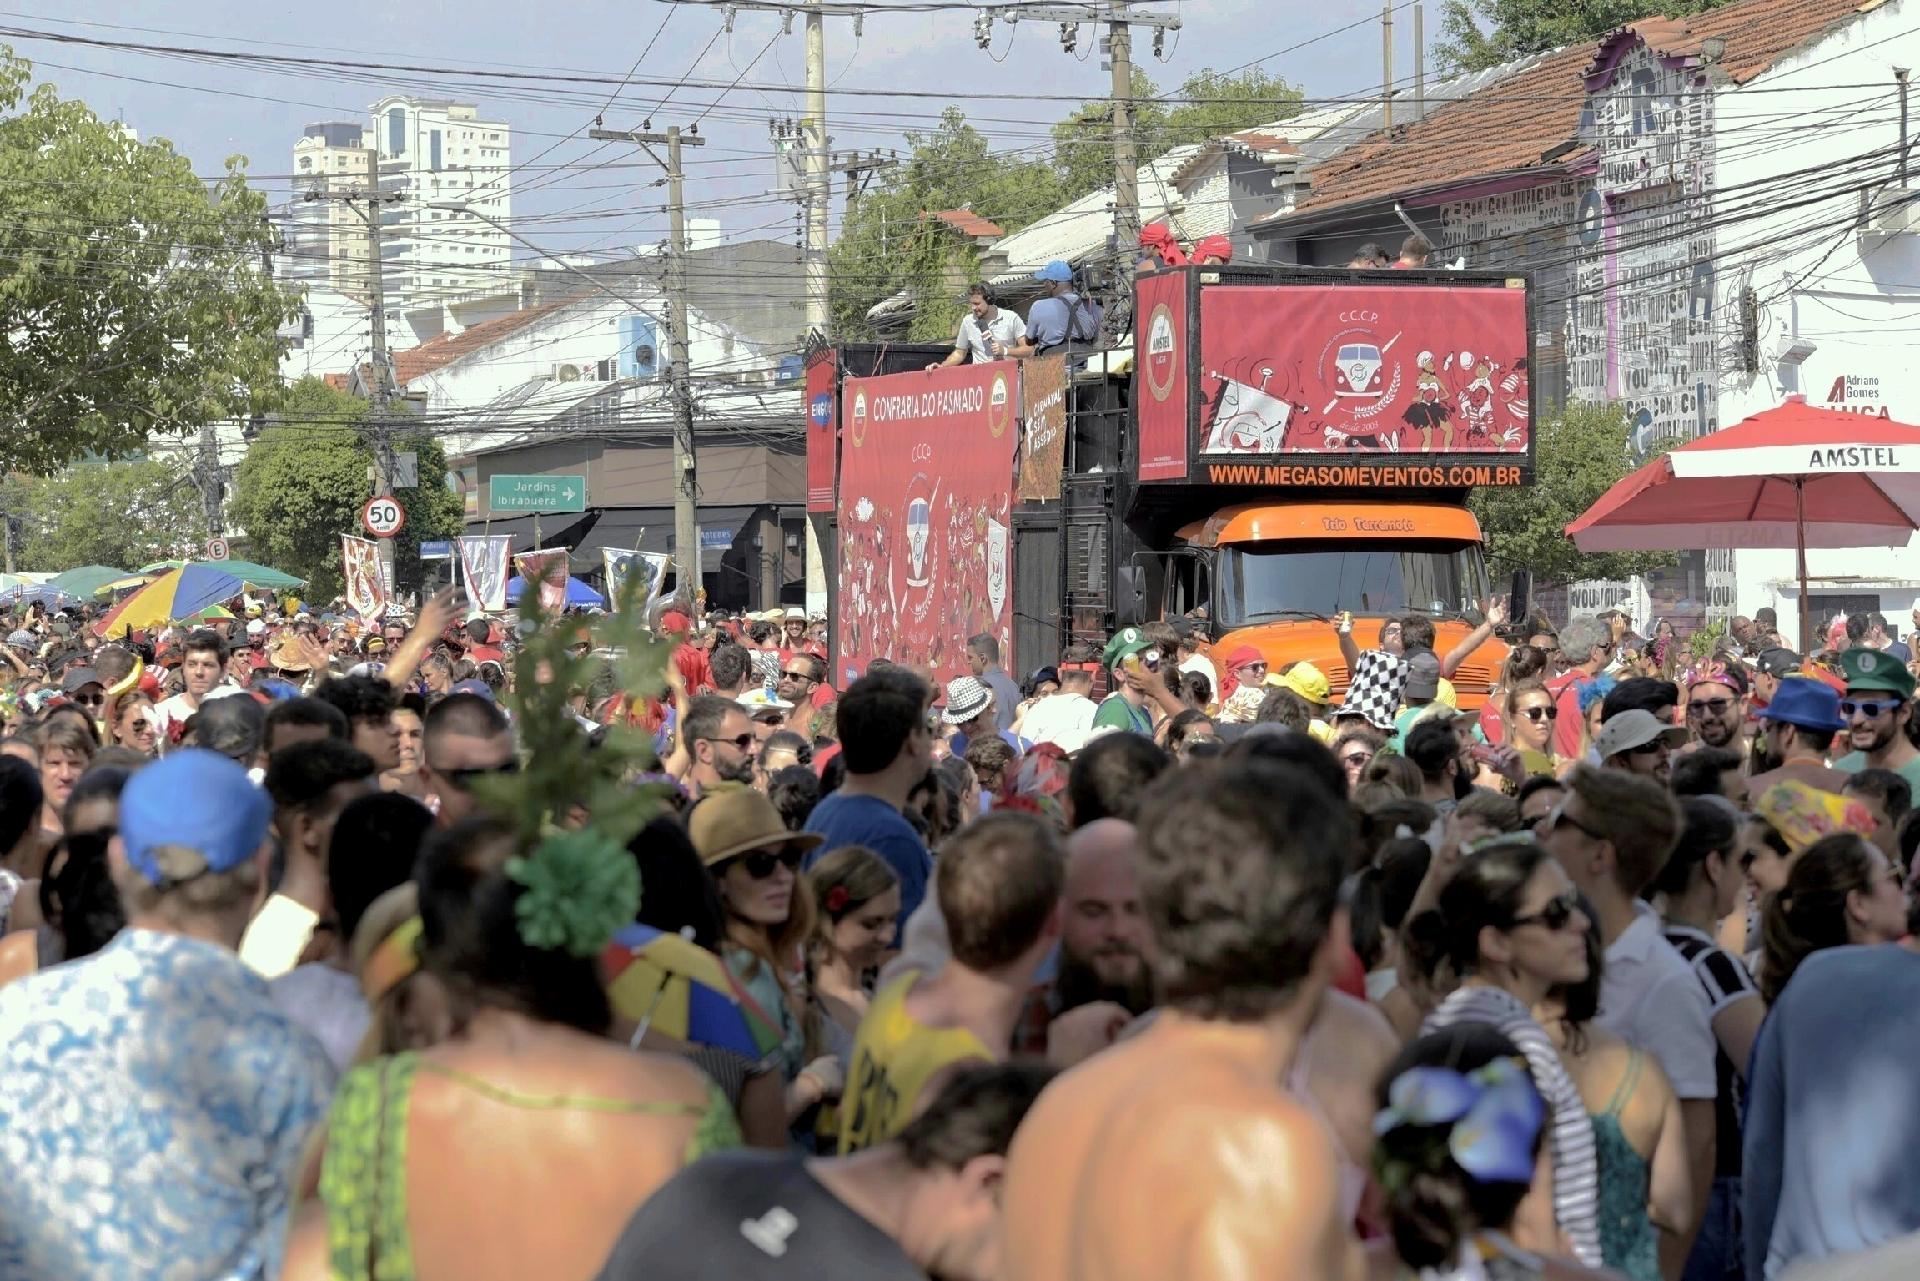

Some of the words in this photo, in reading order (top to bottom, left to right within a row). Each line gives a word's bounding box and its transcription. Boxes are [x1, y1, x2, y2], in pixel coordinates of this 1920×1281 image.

[1847, 375, 1879, 385] Adriano
[1847, 386, 1879, 398] Gomes
[874, 394, 919, 422] CONFRARIA
[921, 391, 935, 418] DO
[937, 385, 983, 417] PASMADO
[1808, 446, 1900, 468] AMSTEL
[1209, 464, 1521, 487] WWW.MEGASOMEVENTOS.COM.BR
[513, 481, 557, 492] Jardins
[498, 497, 557, 508] Ibirapuera
[369, 506, 397, 524] 50
[214, 544, 222, 556] E
